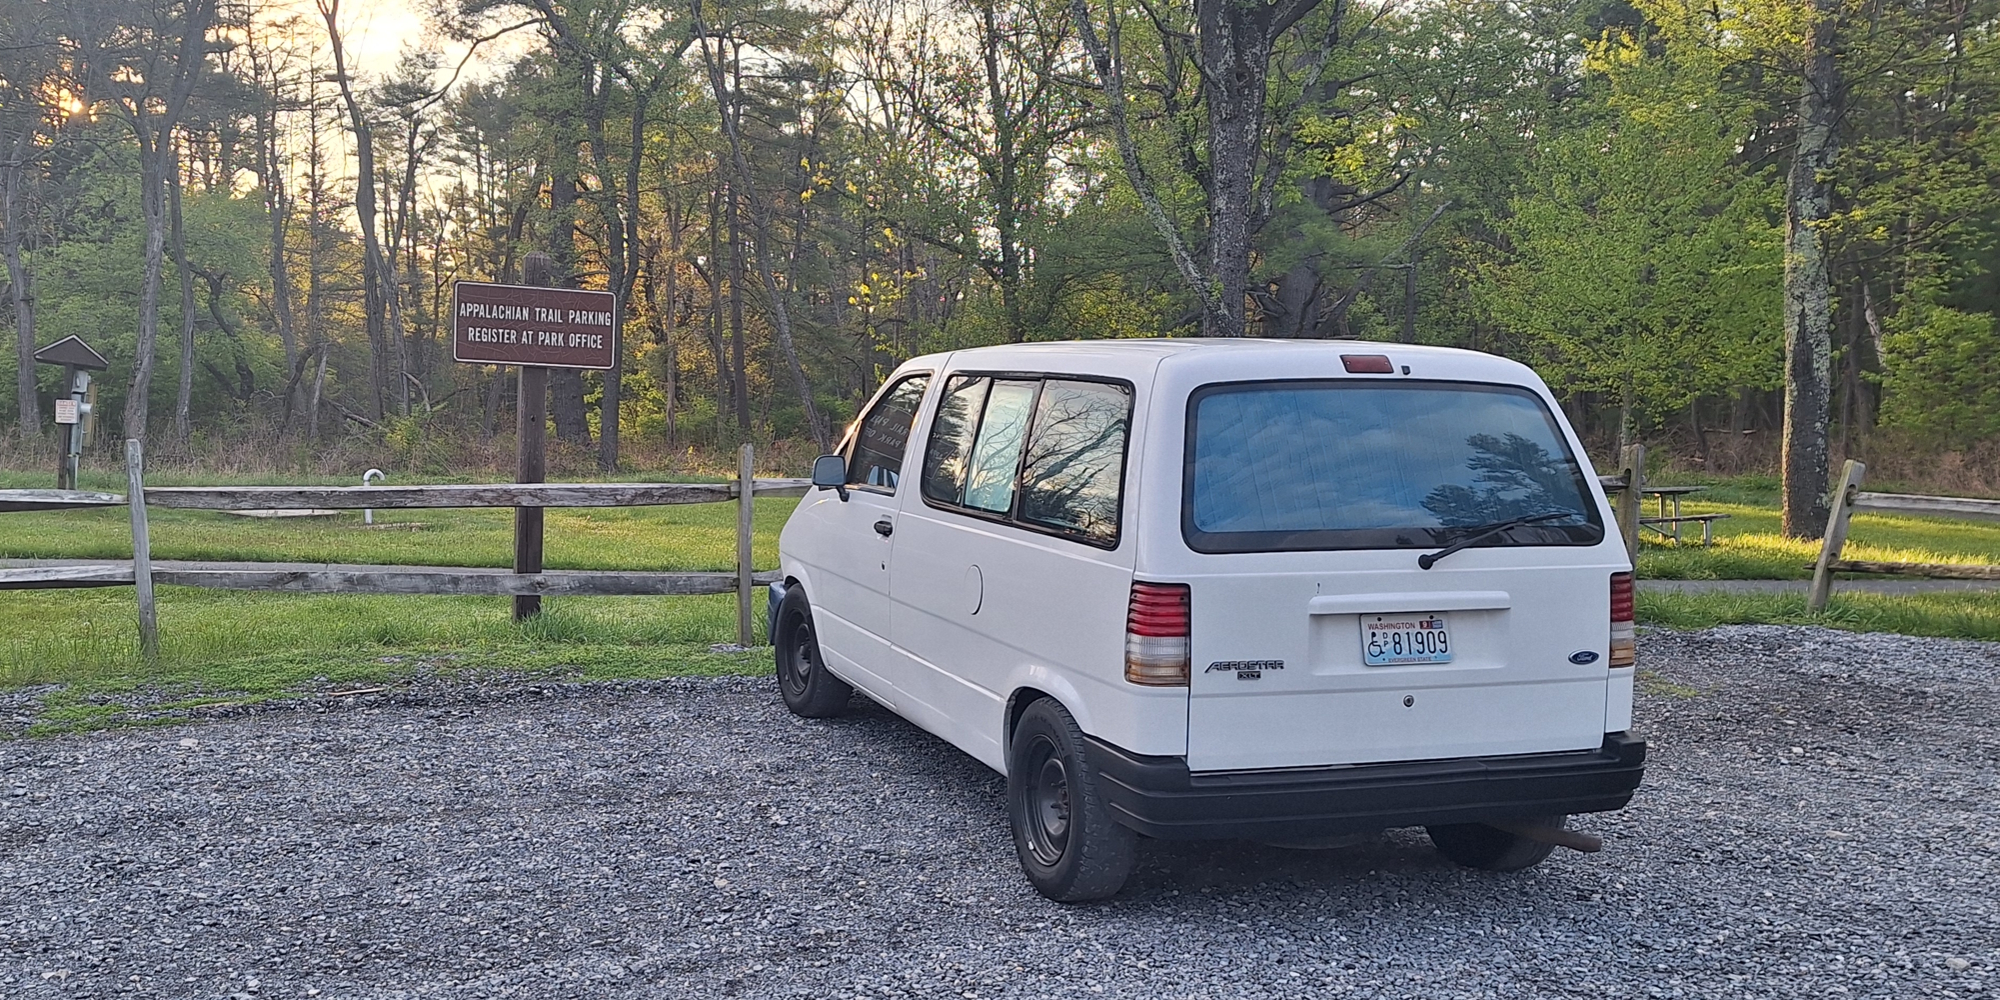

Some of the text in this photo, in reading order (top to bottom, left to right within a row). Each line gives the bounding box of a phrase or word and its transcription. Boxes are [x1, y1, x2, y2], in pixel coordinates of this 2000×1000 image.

[459, 302, 611, 326] APPALACHIAN TRAIL PARKING
[468, 327, 603, 349] REGISTER AT PARK OFFICE
[1367, 622, 1416, 631] WASHINGTON
[1392, 630, 1448, 655] 81909
[1204, 660, 1284, 673] AEROSTAR
